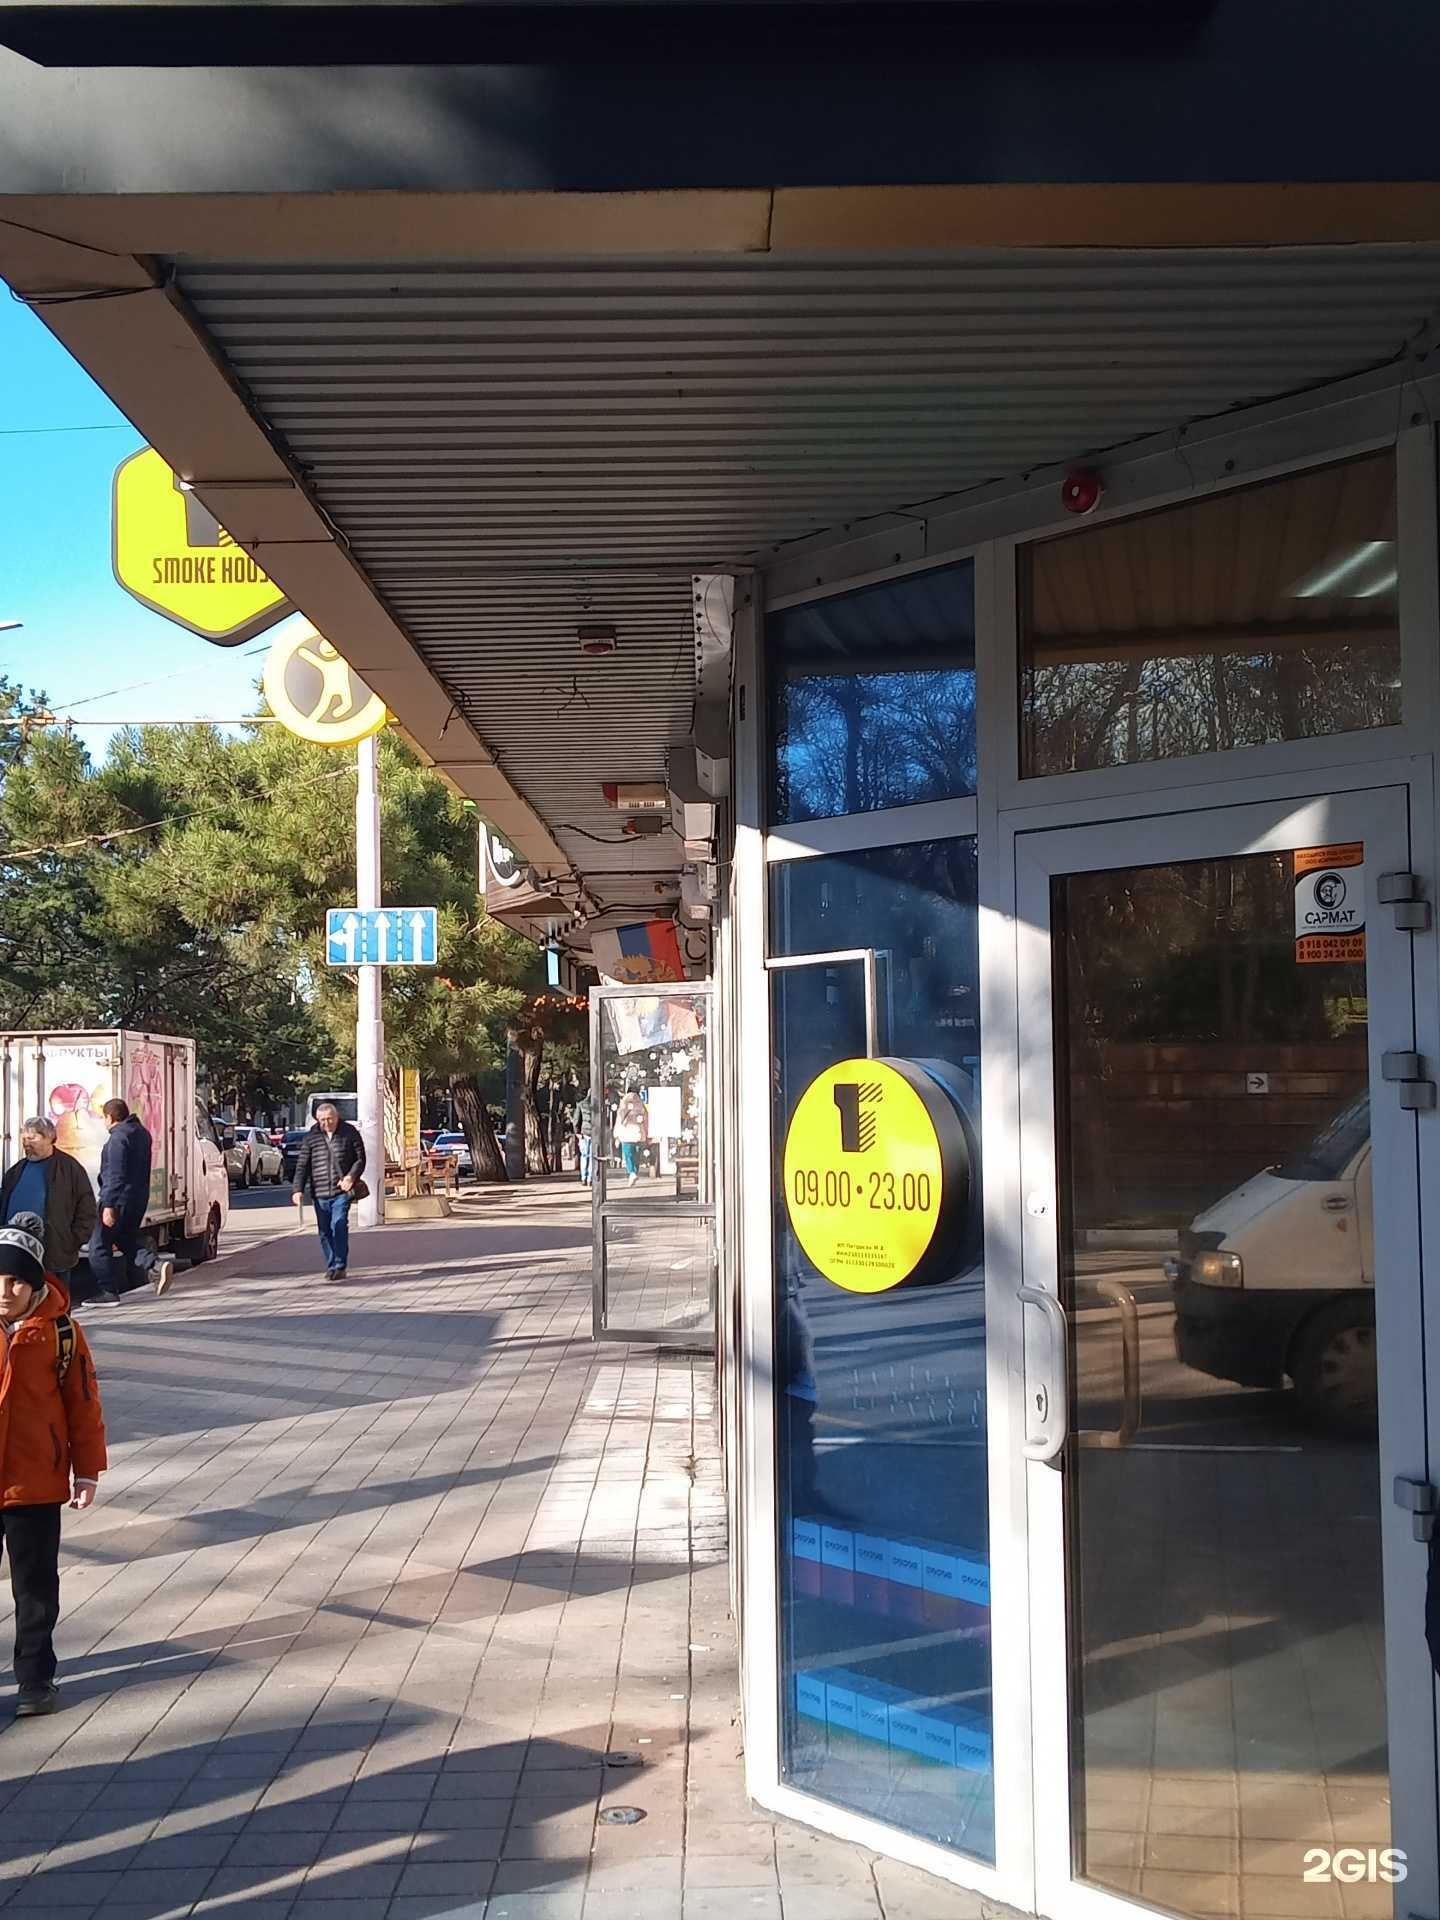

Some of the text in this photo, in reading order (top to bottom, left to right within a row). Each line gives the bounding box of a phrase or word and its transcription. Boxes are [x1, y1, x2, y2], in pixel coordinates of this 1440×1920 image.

[153, 557, 216, 584] SMOKE
[1304, 910, 1356, 925] САРМАТ
[794, 1169, 931, 1211] 09.00 23.00
